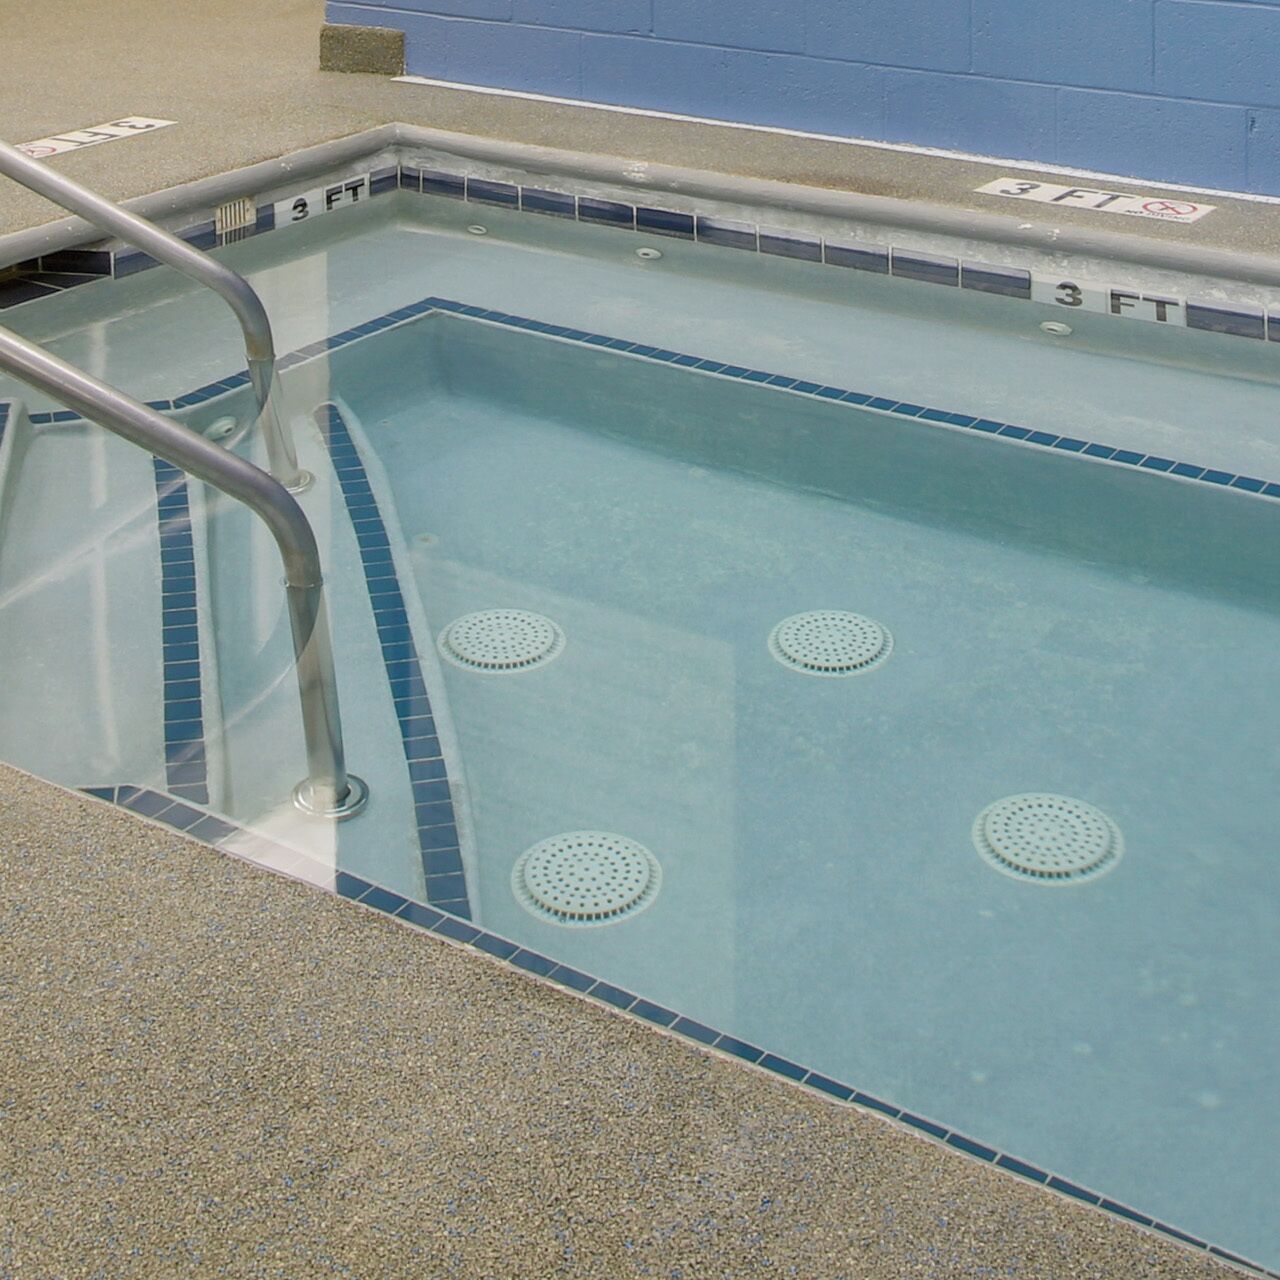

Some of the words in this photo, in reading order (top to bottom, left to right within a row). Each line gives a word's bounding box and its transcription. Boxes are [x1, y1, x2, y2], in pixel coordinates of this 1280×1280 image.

[49, 130, 119, 146] FT
[110, 121, 155, 130] 3
[292, 198, 309, 221] 3
[326, 177, 364, 211] FT
[1000, 182, 1040, 196] 3
[1050, 188, 1136, 208] FT
[1055, 281, 1083, 307] 3
[1110, 289, 1180, 322] FT
